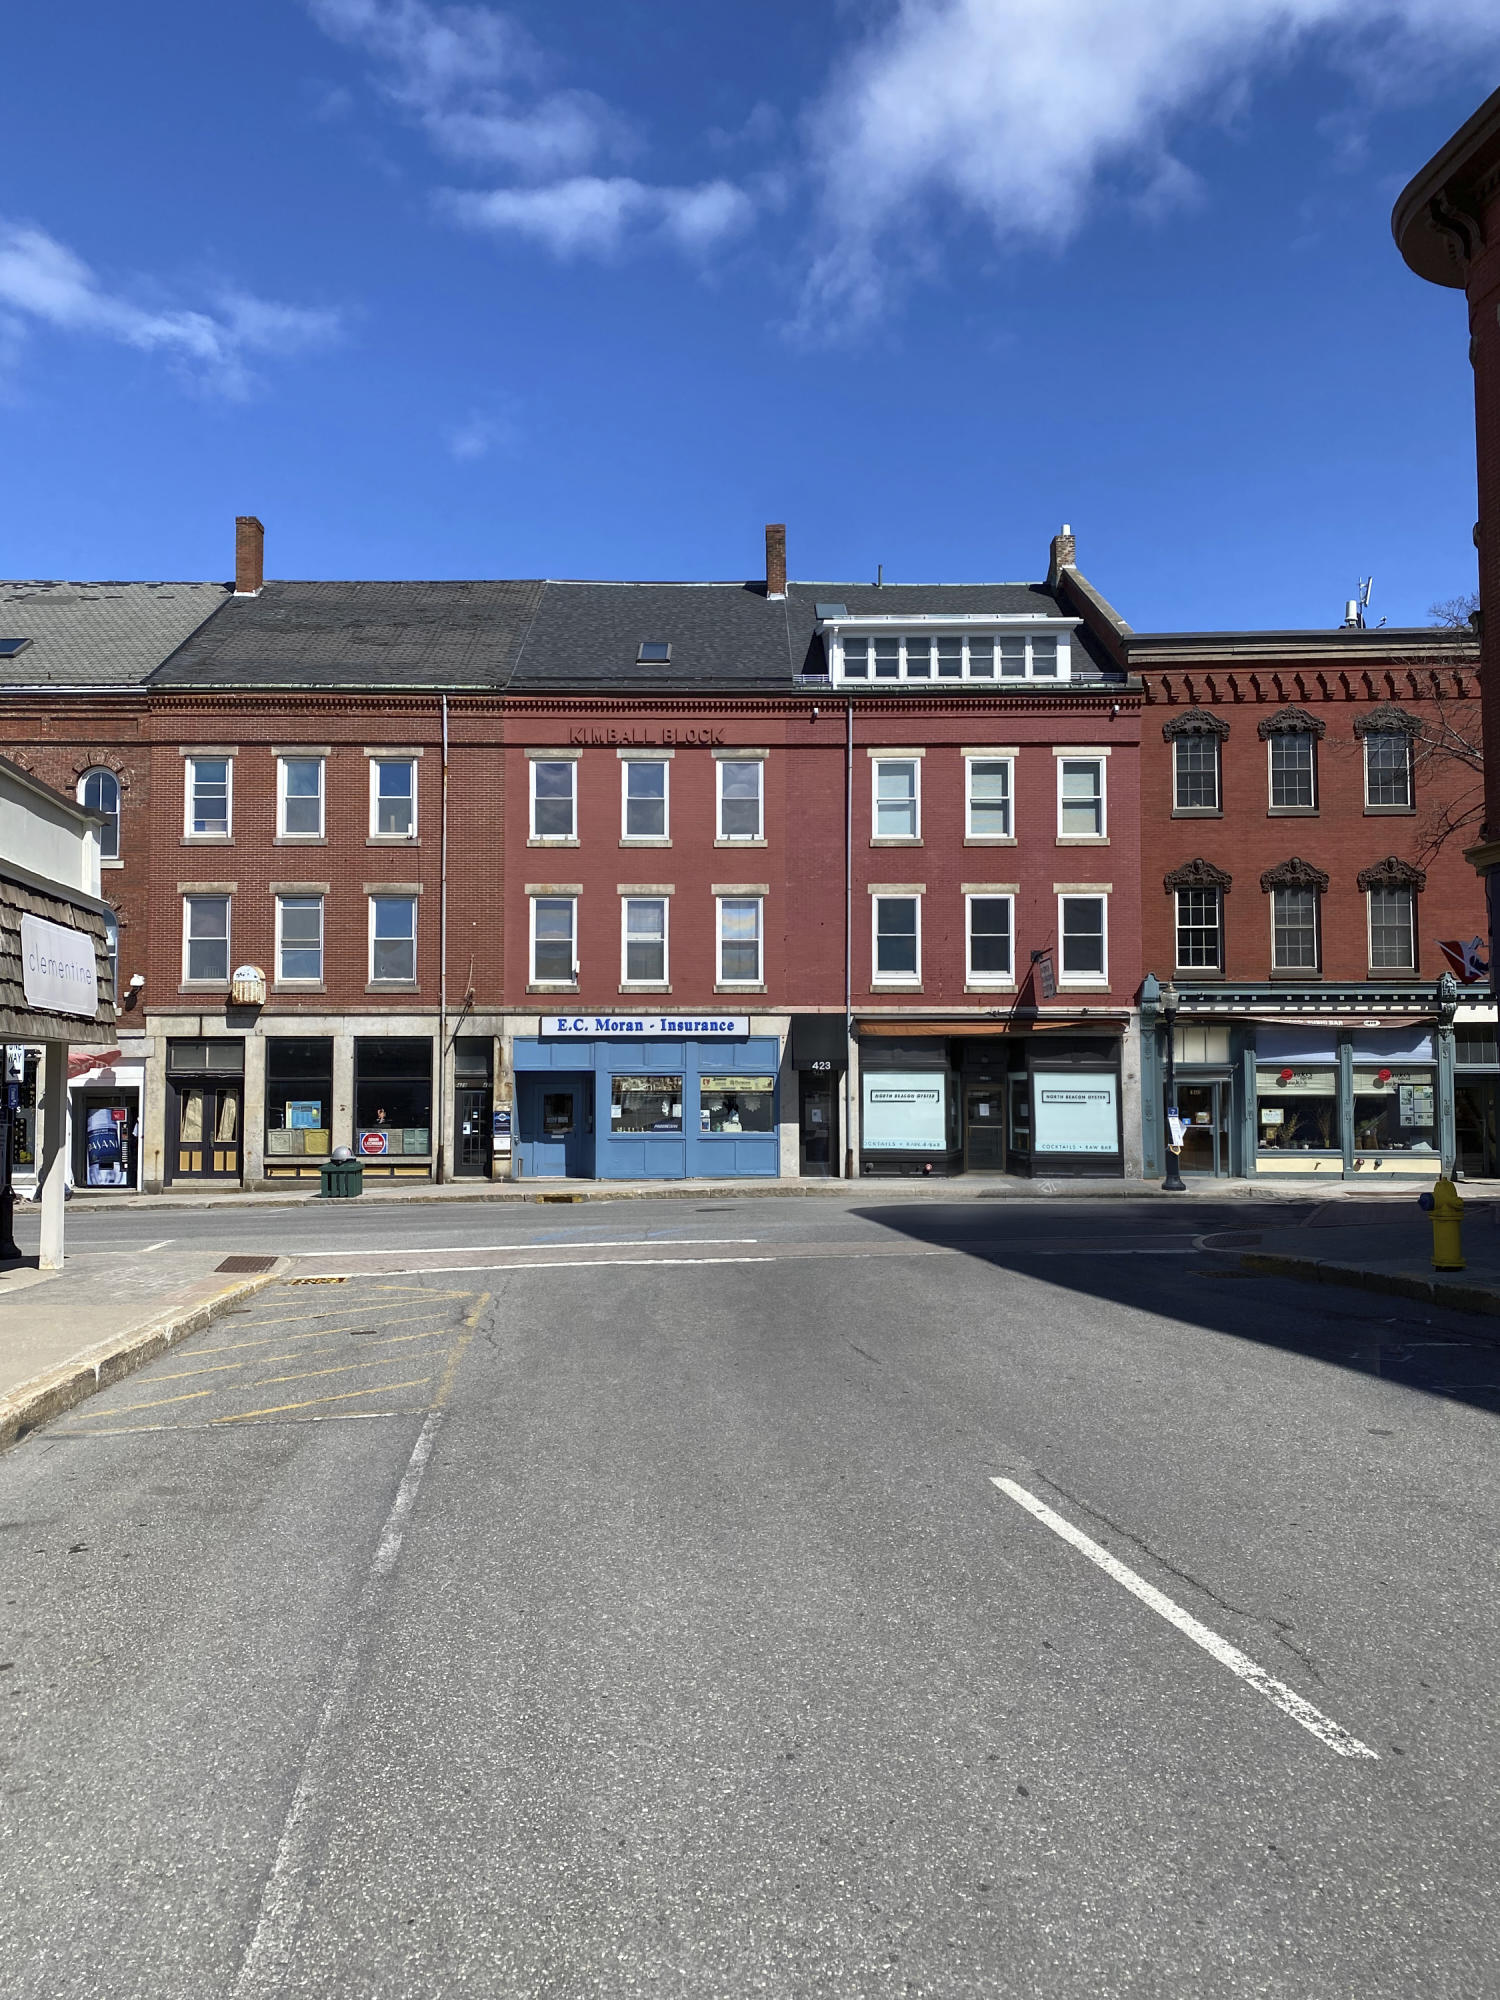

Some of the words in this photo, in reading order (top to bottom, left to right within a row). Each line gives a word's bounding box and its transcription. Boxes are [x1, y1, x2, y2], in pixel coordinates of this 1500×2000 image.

[570, 728, 656, 744] KIMBALL
[662, 728, 725, 744] BLOCK
[29, 942, 92, 985] clementine
[557, 1018, 589, 1032] E.C.
[595, 1018, 644, 1032] Moran
[660, 1018, 735, 1032] Insurance
[8, 1053, 22, 1063] WAY
[811, 1061, 831, 1070] 423
